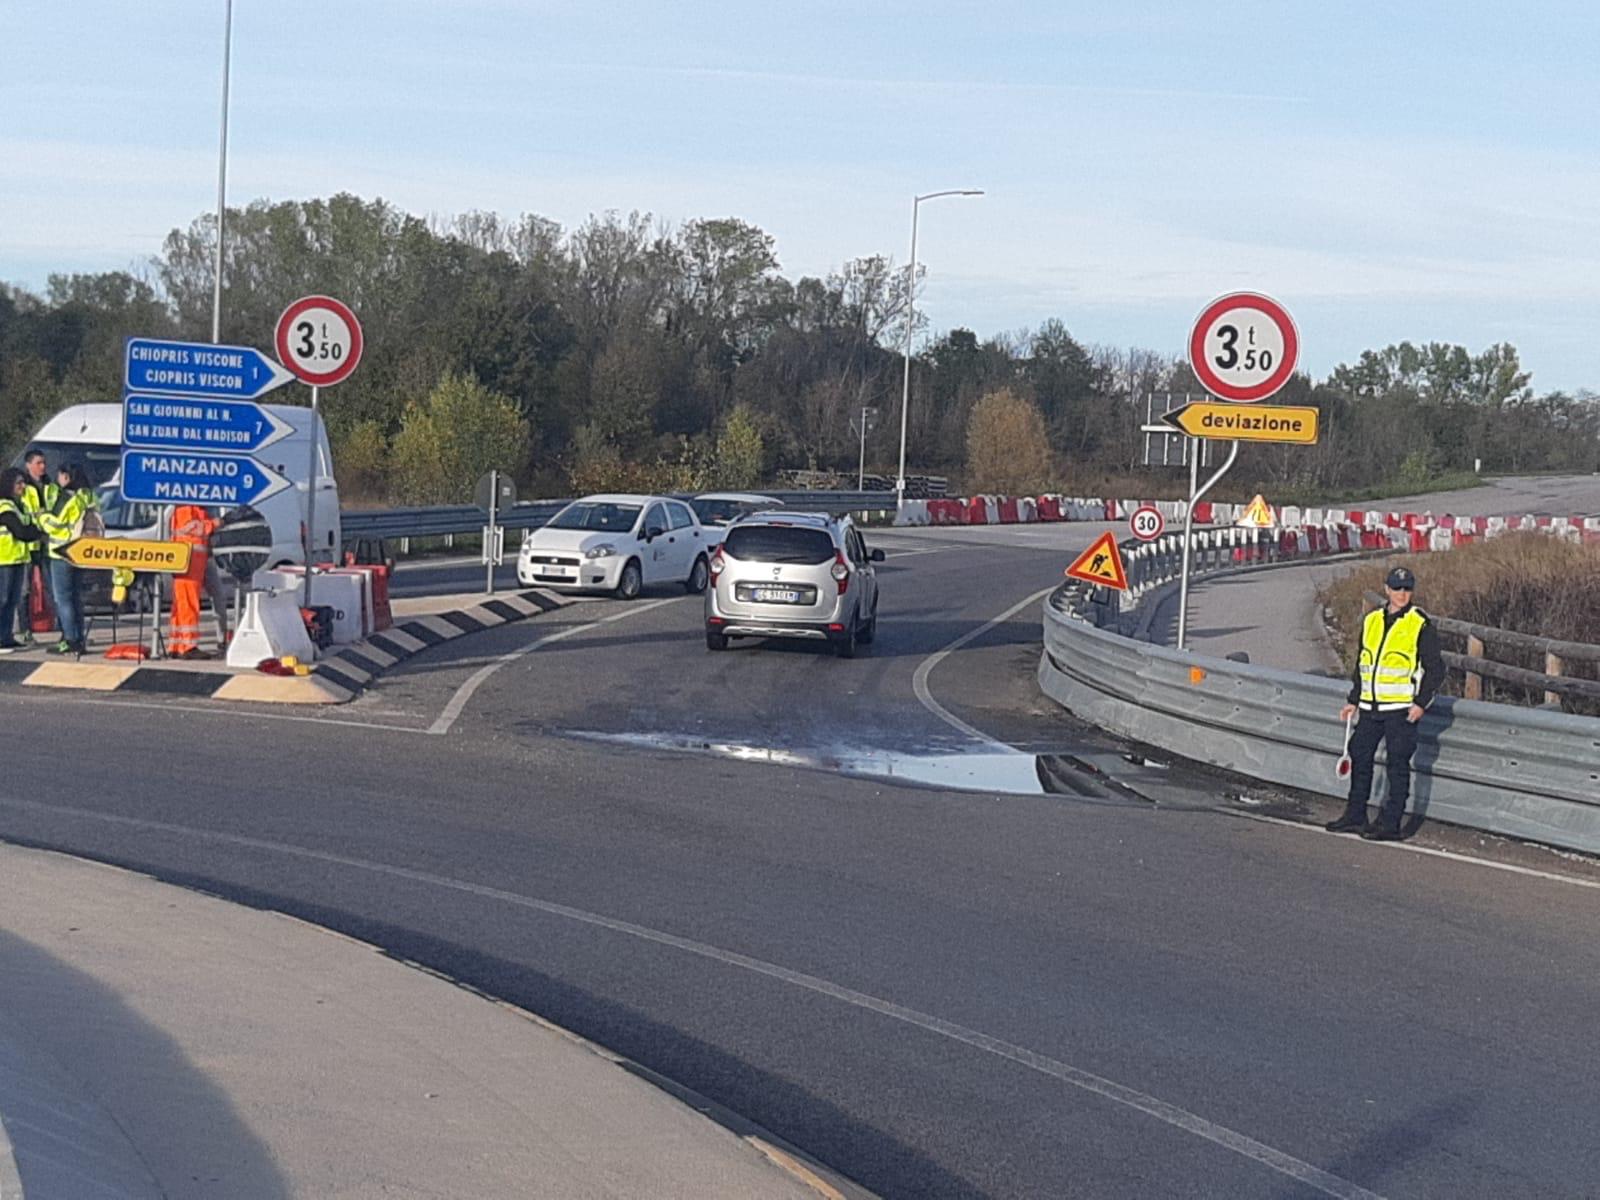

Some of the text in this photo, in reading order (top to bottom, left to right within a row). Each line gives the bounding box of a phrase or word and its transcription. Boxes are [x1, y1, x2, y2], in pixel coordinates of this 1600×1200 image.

[131, 346, 244, 369] CHIOPRIS VISCONE
[199, 373, 243, 389] VISCON
[252, 367, 258, 379] 1
[129, 403, 232, 422] SAN GIOVANNI AL N.
[255, 421, 263, 435] 7
[1201, 412, 1303, 432] deviazione
[128, 424, 250, 443] SAN ZUAN DAL NADISON
[141, 457, 239, 477] MANZANO
[243, 474, 254, 489] 9
[154, 481, 237, 501] MANZAN
[1137, 516, 1156, 531] 30
[82, 545, 175, 563] deviazione
